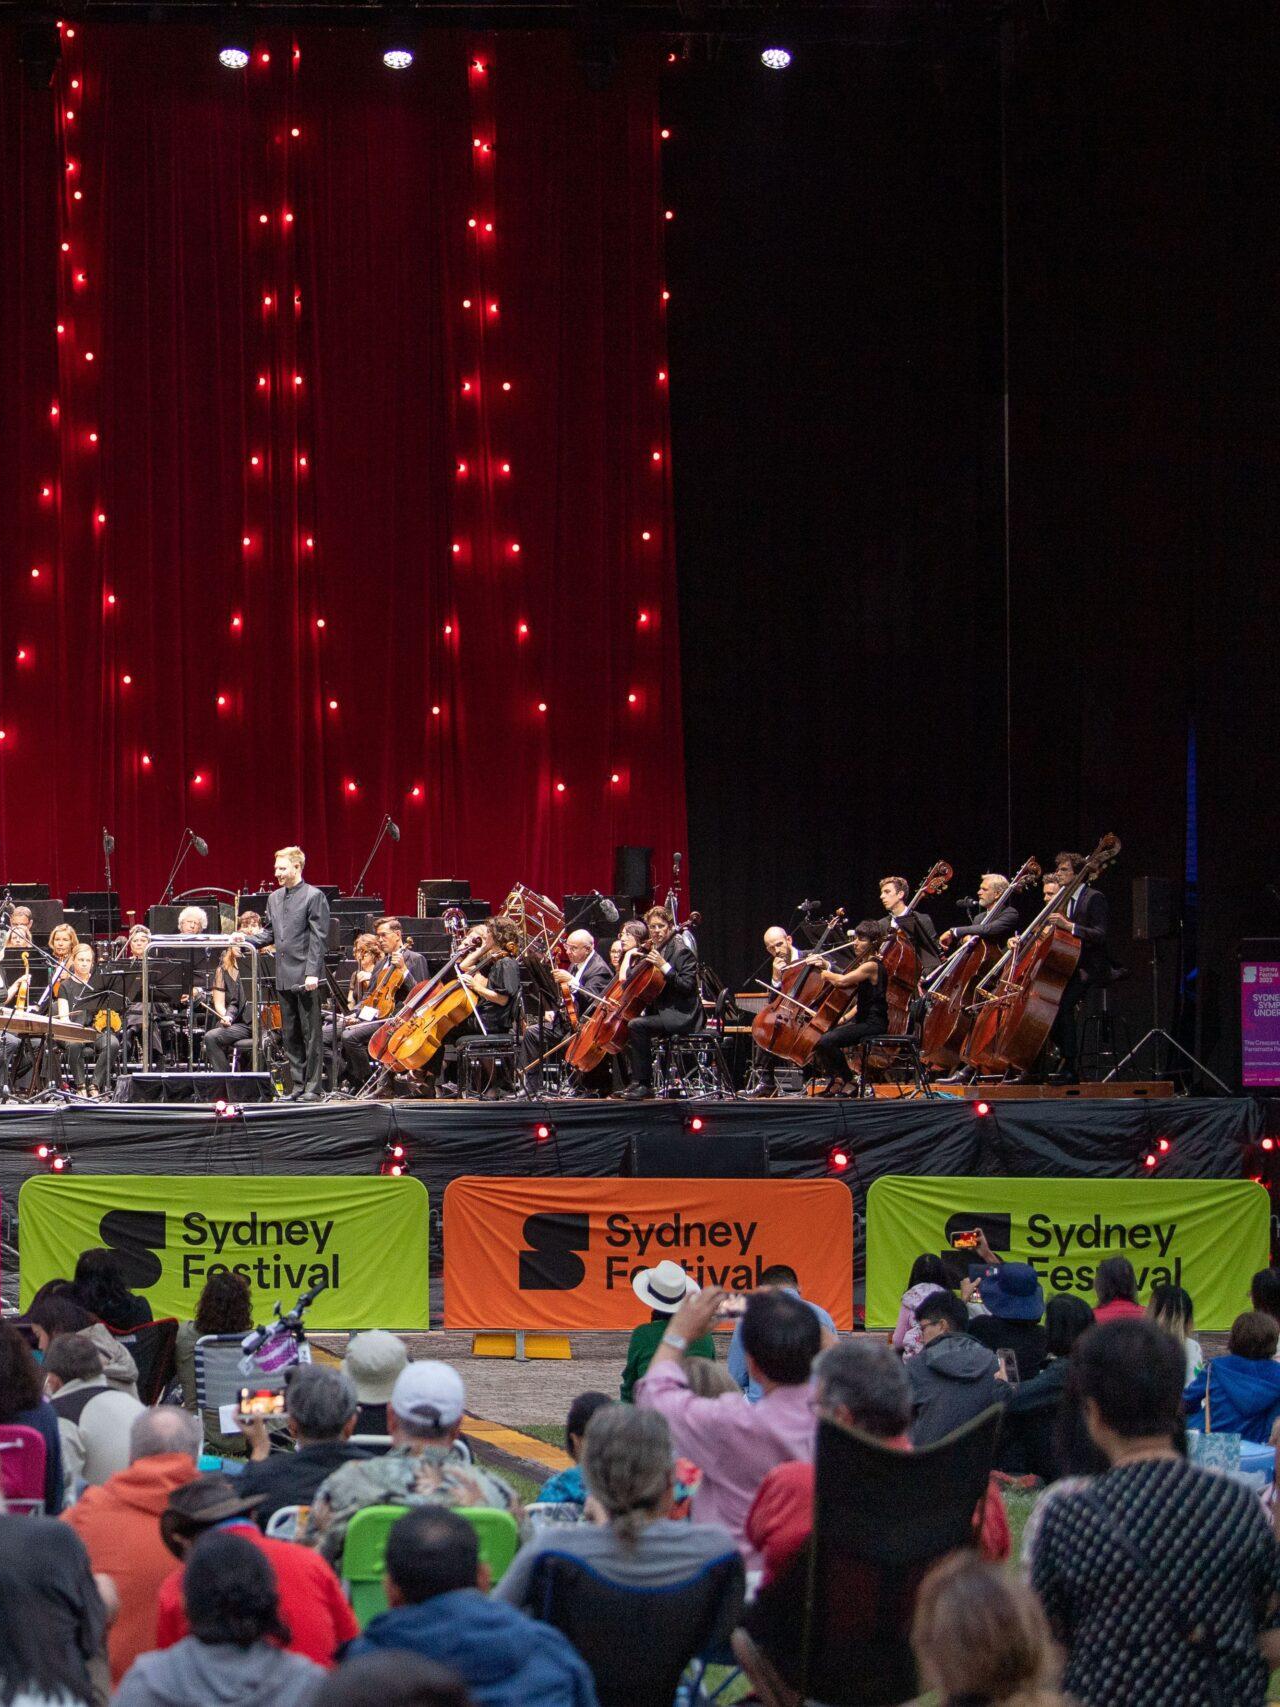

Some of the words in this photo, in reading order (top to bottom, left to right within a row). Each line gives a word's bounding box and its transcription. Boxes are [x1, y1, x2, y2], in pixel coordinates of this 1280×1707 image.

[182, 1211, 334, 1254] Sydney
[605, 1212, 757, 1256] Sydney
[1026, 1213, 1177, 1257] Sydney
[1026, 1256, 1182, 1292] Fesval
